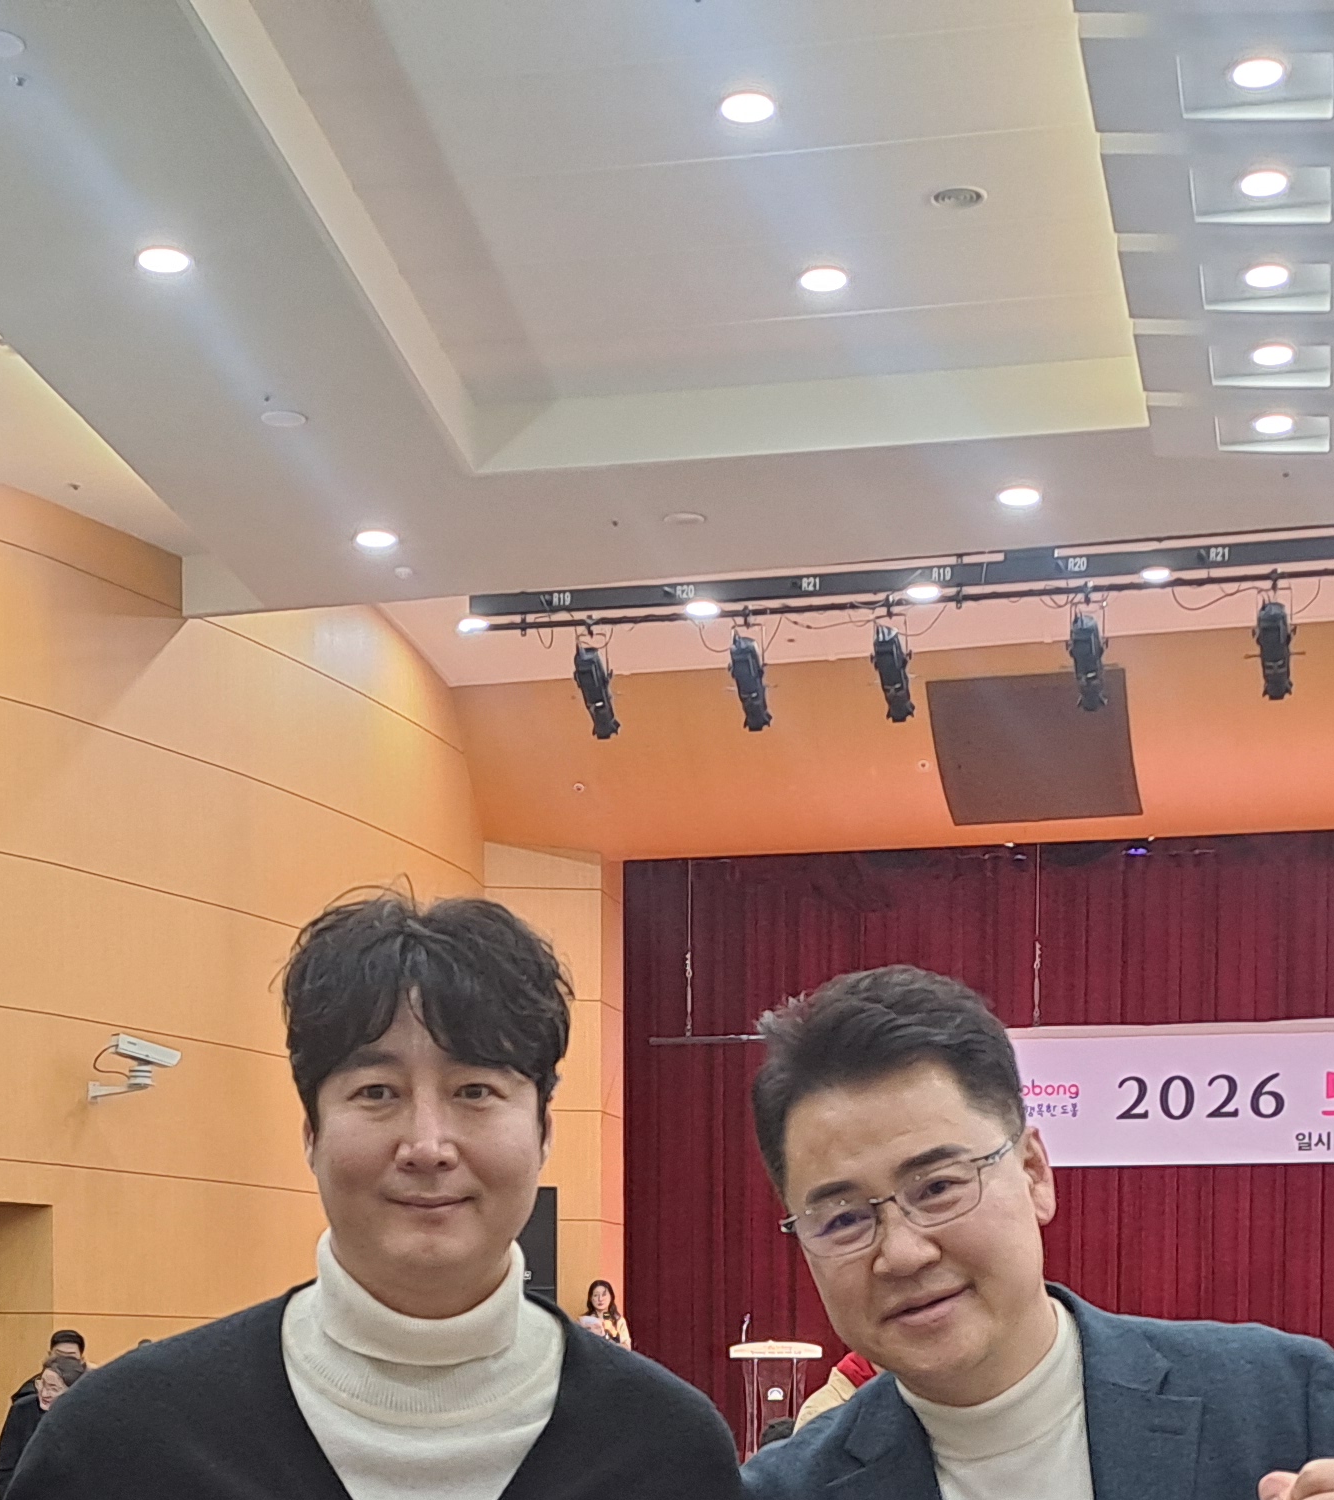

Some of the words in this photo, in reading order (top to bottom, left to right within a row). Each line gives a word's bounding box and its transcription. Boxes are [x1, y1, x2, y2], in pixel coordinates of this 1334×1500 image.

[1209, 547, 1229, 561] R21
[1067, 557, 1087, 571] R20
[932, 567, 951, 581] R19
[801, 577, 820, 591] R21
[552, 592, 571, 605] R19
[676, 585, 695, 598] R20
[1022, 1079, 1079, 1099] obong
[1115, 1072, 1285, 1120] 2026
[1295, 1131, 1331, 1151] 일시
